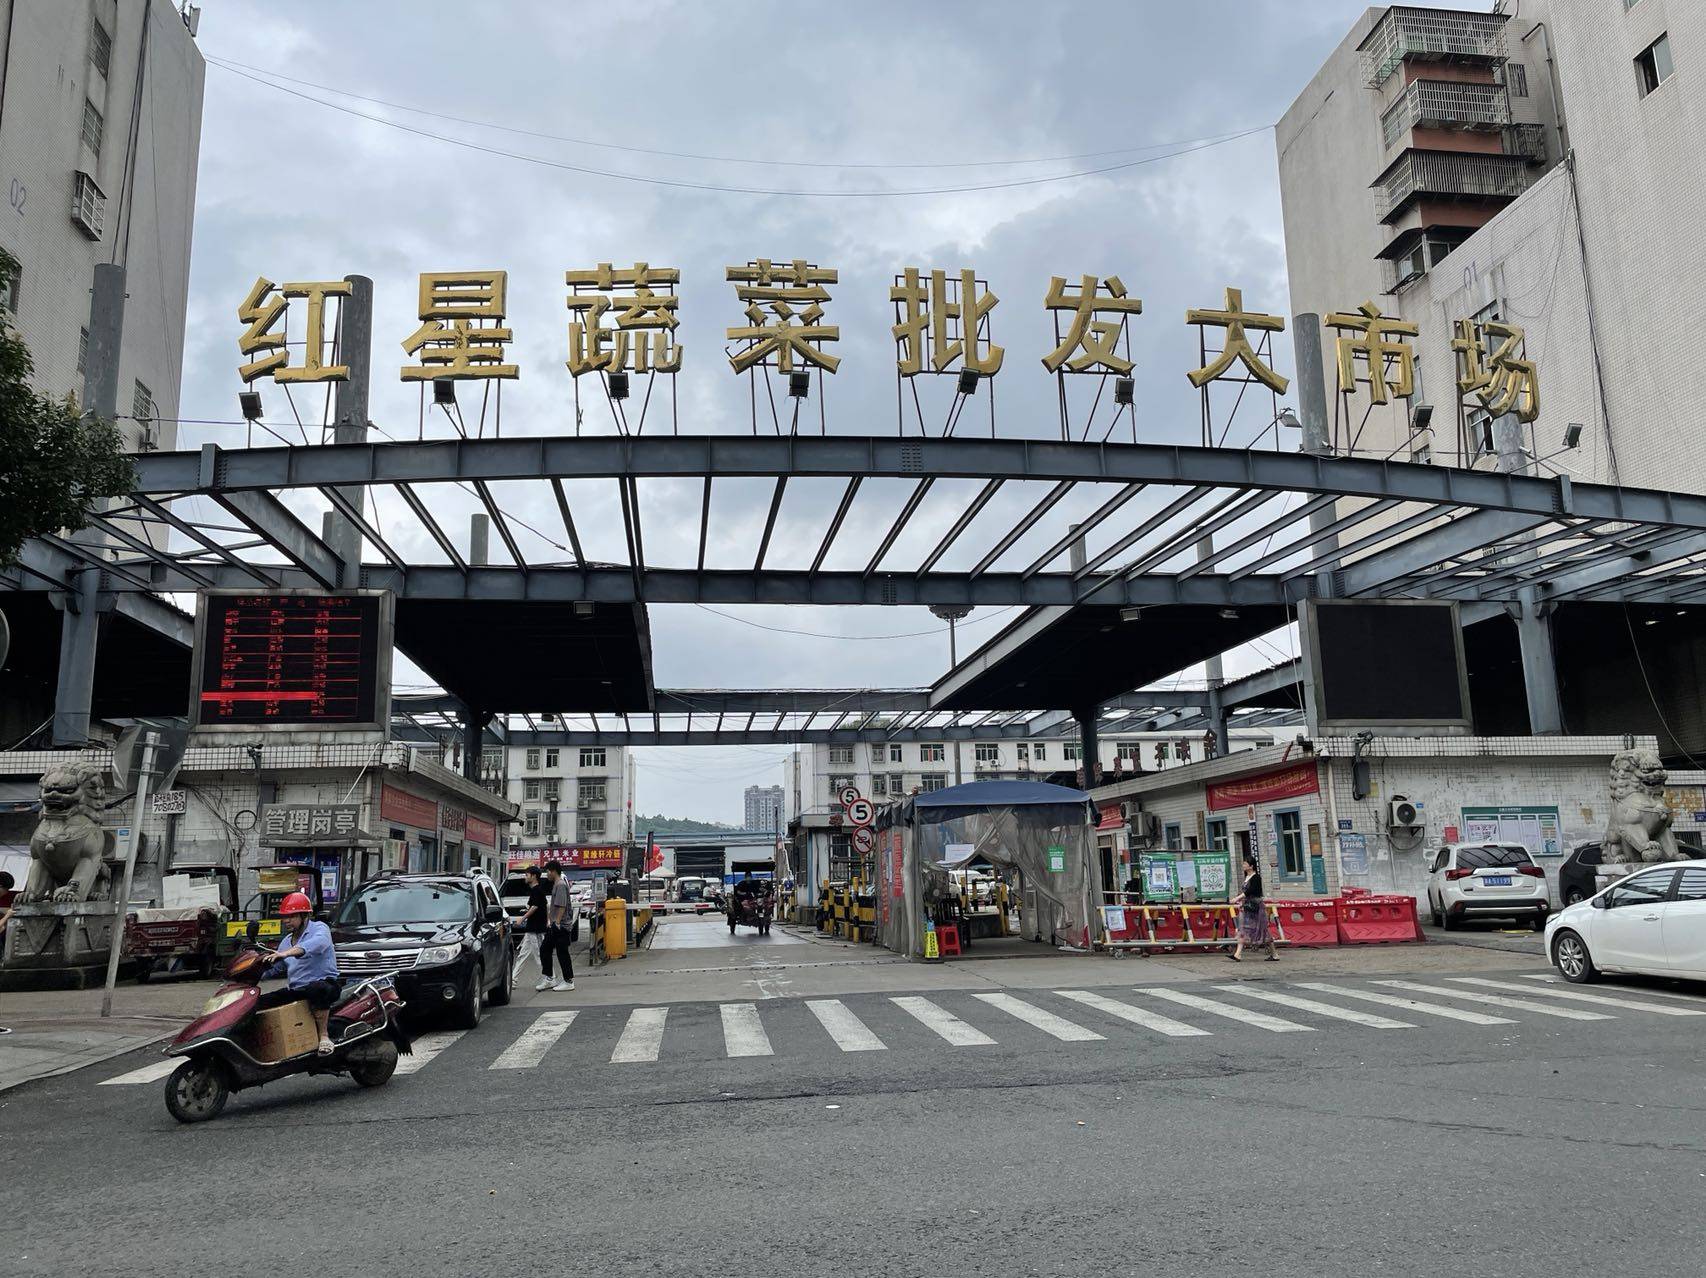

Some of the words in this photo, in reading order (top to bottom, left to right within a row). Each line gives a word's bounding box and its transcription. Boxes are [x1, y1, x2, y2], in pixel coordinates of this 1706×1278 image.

[11, 177, 27, 216] 02
[238, 258, 1540, 423] 红星蔬菜批发大市场
[846, 791, 855, 804] 5
[265, 808, 356, 836] 管理岗亭
[855, 805, 867, 820] 5
